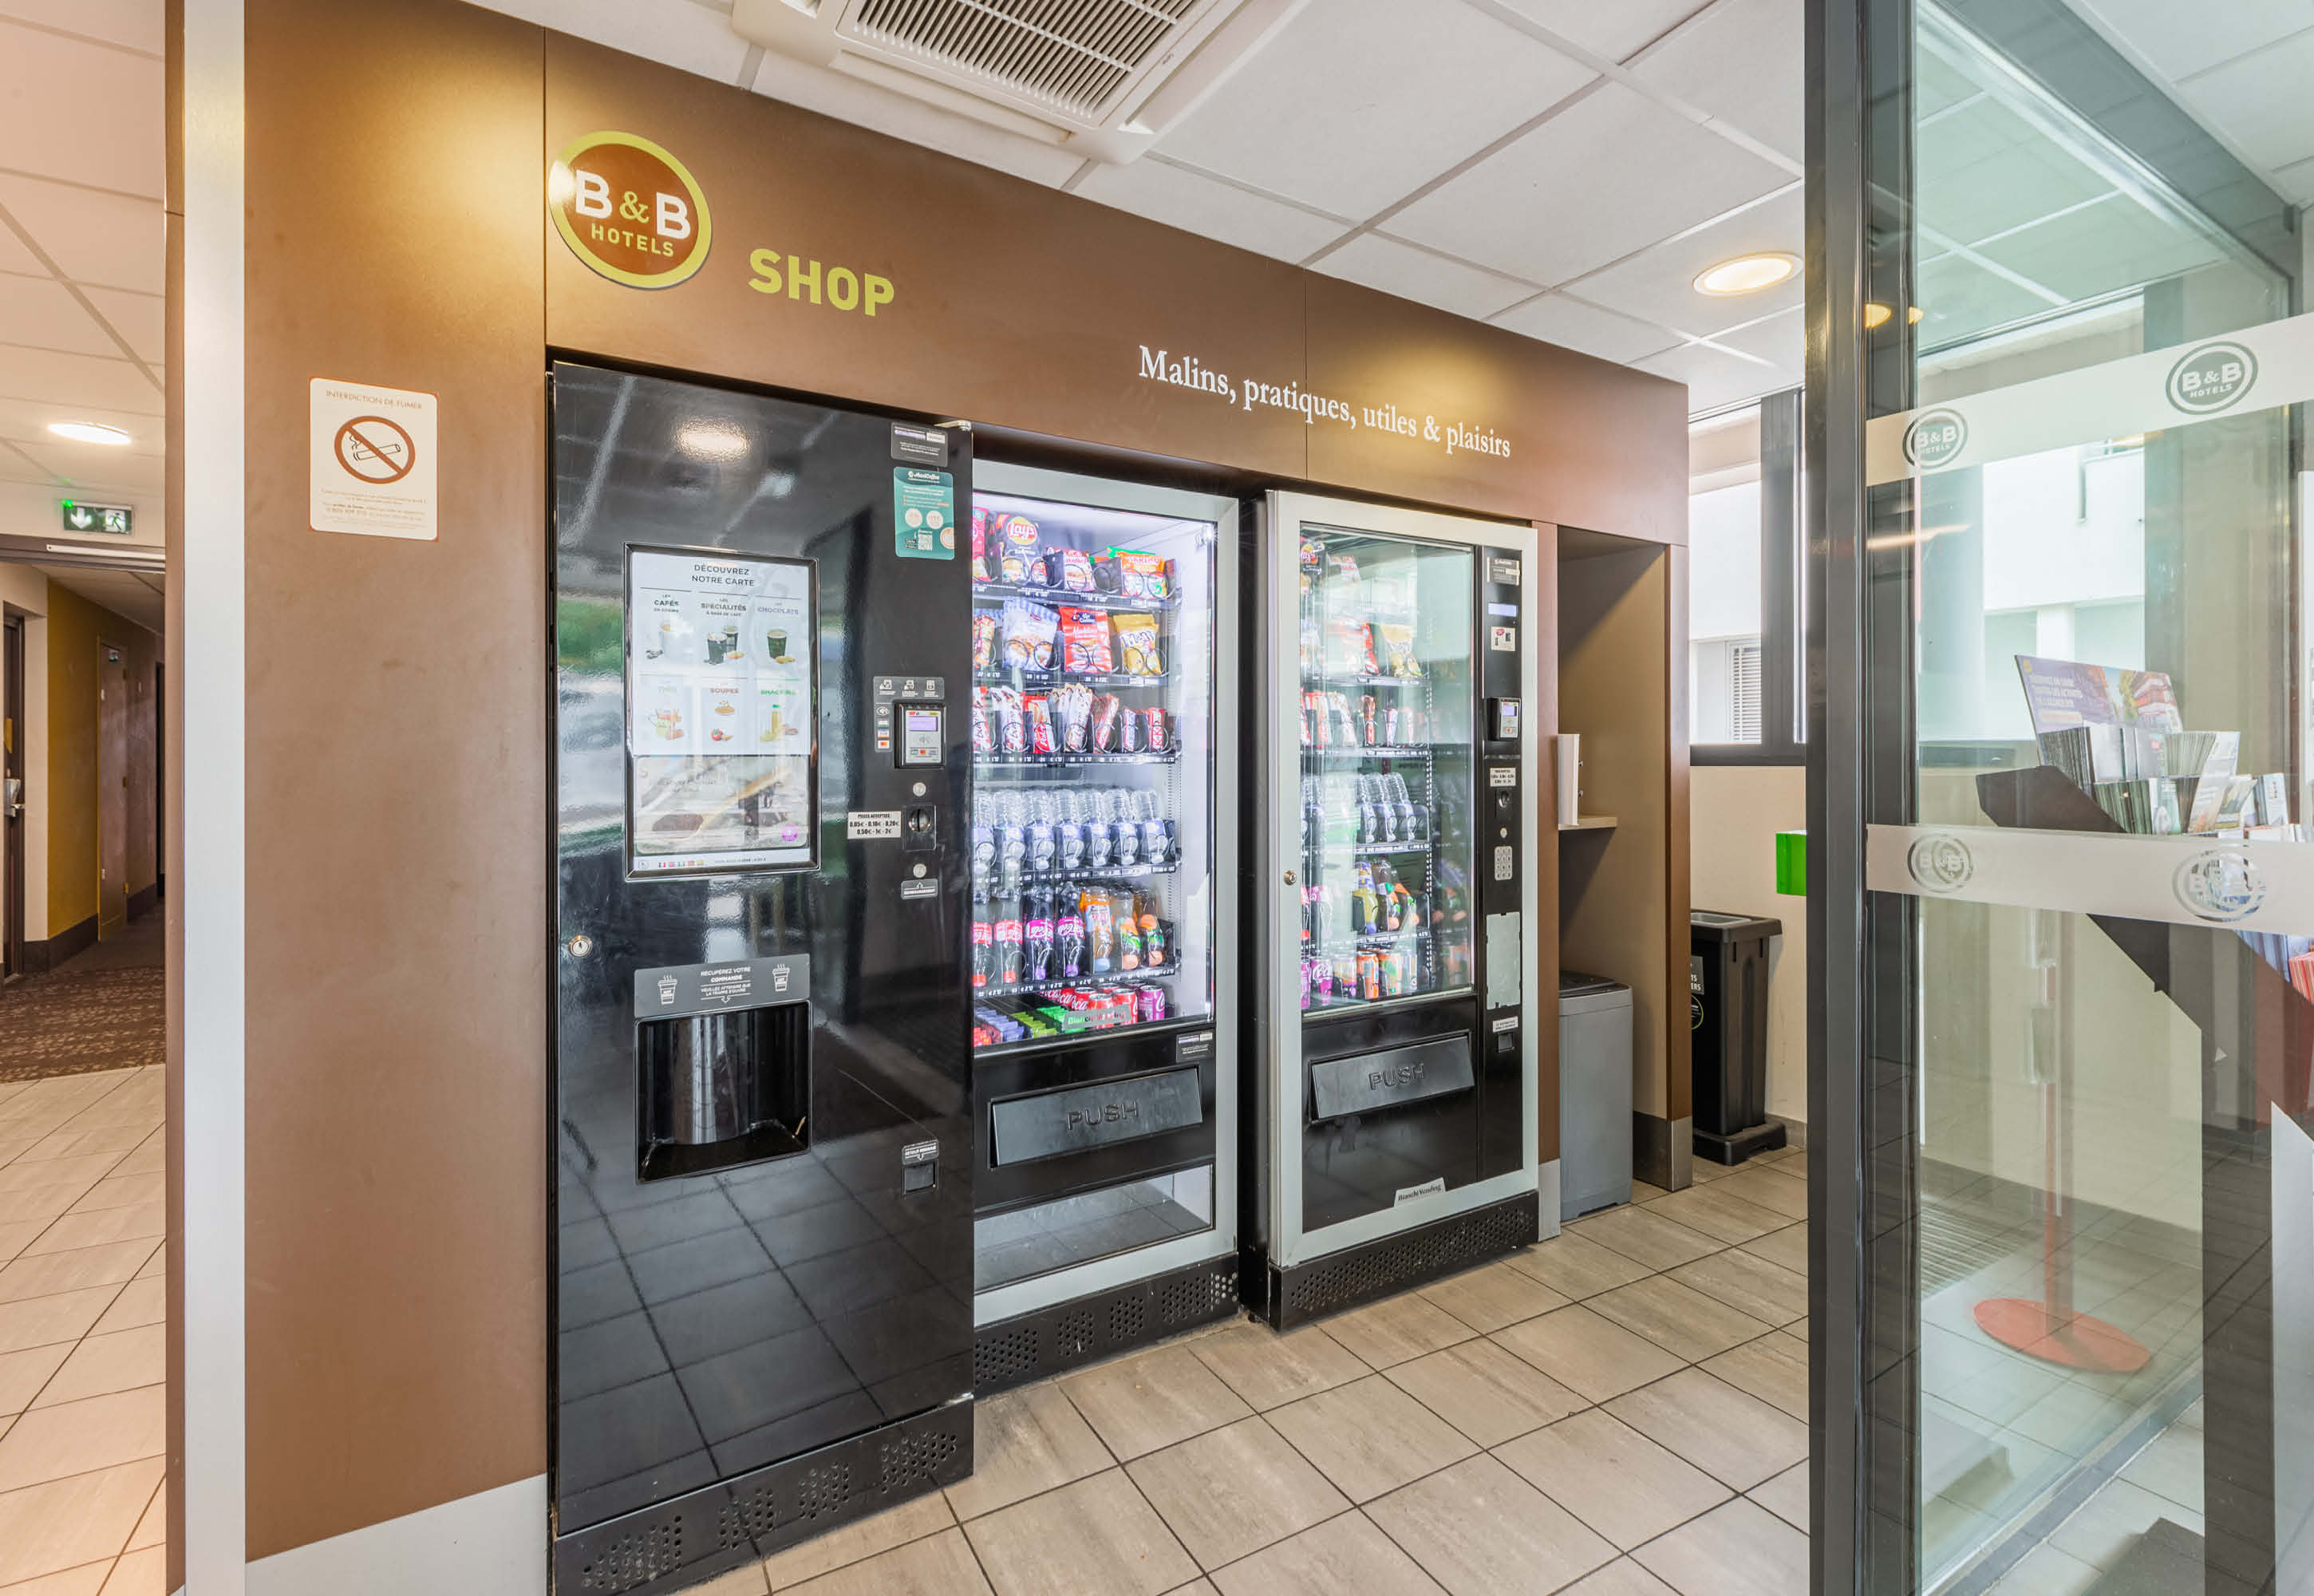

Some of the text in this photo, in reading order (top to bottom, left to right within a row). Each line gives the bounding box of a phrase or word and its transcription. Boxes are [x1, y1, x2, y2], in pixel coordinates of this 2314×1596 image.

[590, 223, 674, 258] HOTELS
[748, 248, 894, 317] SHOP
[1139, 345, 1511, 458] Malins, pratiques, utiles & plaisirs
[2190, 383, 2233, 398] HOTELS
[691, 575, 754, 587] NOTRE CARTE
[693, 563, 750, 575] DÉCOUVREZ
[1368, 1062, 1424, 1091] PUSH
[1065, 1100, 1138, 1131] PUSH
